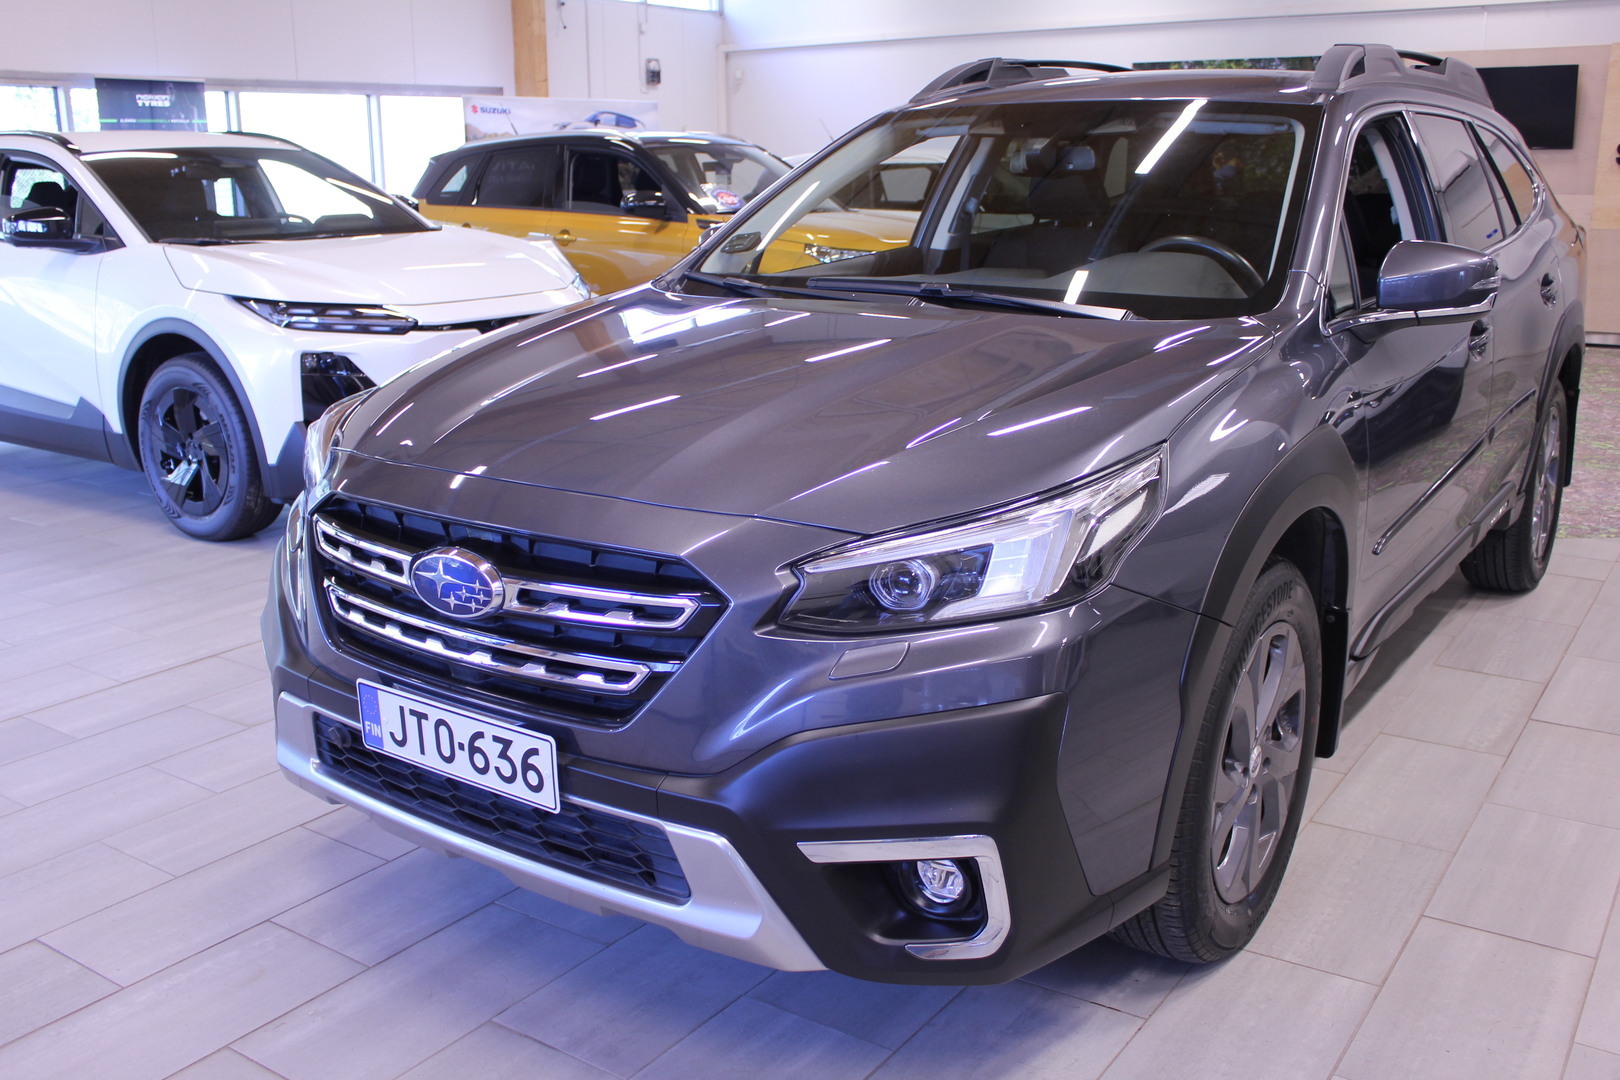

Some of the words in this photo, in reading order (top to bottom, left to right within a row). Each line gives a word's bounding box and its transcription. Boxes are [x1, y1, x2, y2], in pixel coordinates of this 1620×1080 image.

[479, 106, 511, 114] SUZUKI
[364, 721, 382, 738] FIN
[389, 705, 545, 794] JTO-636
